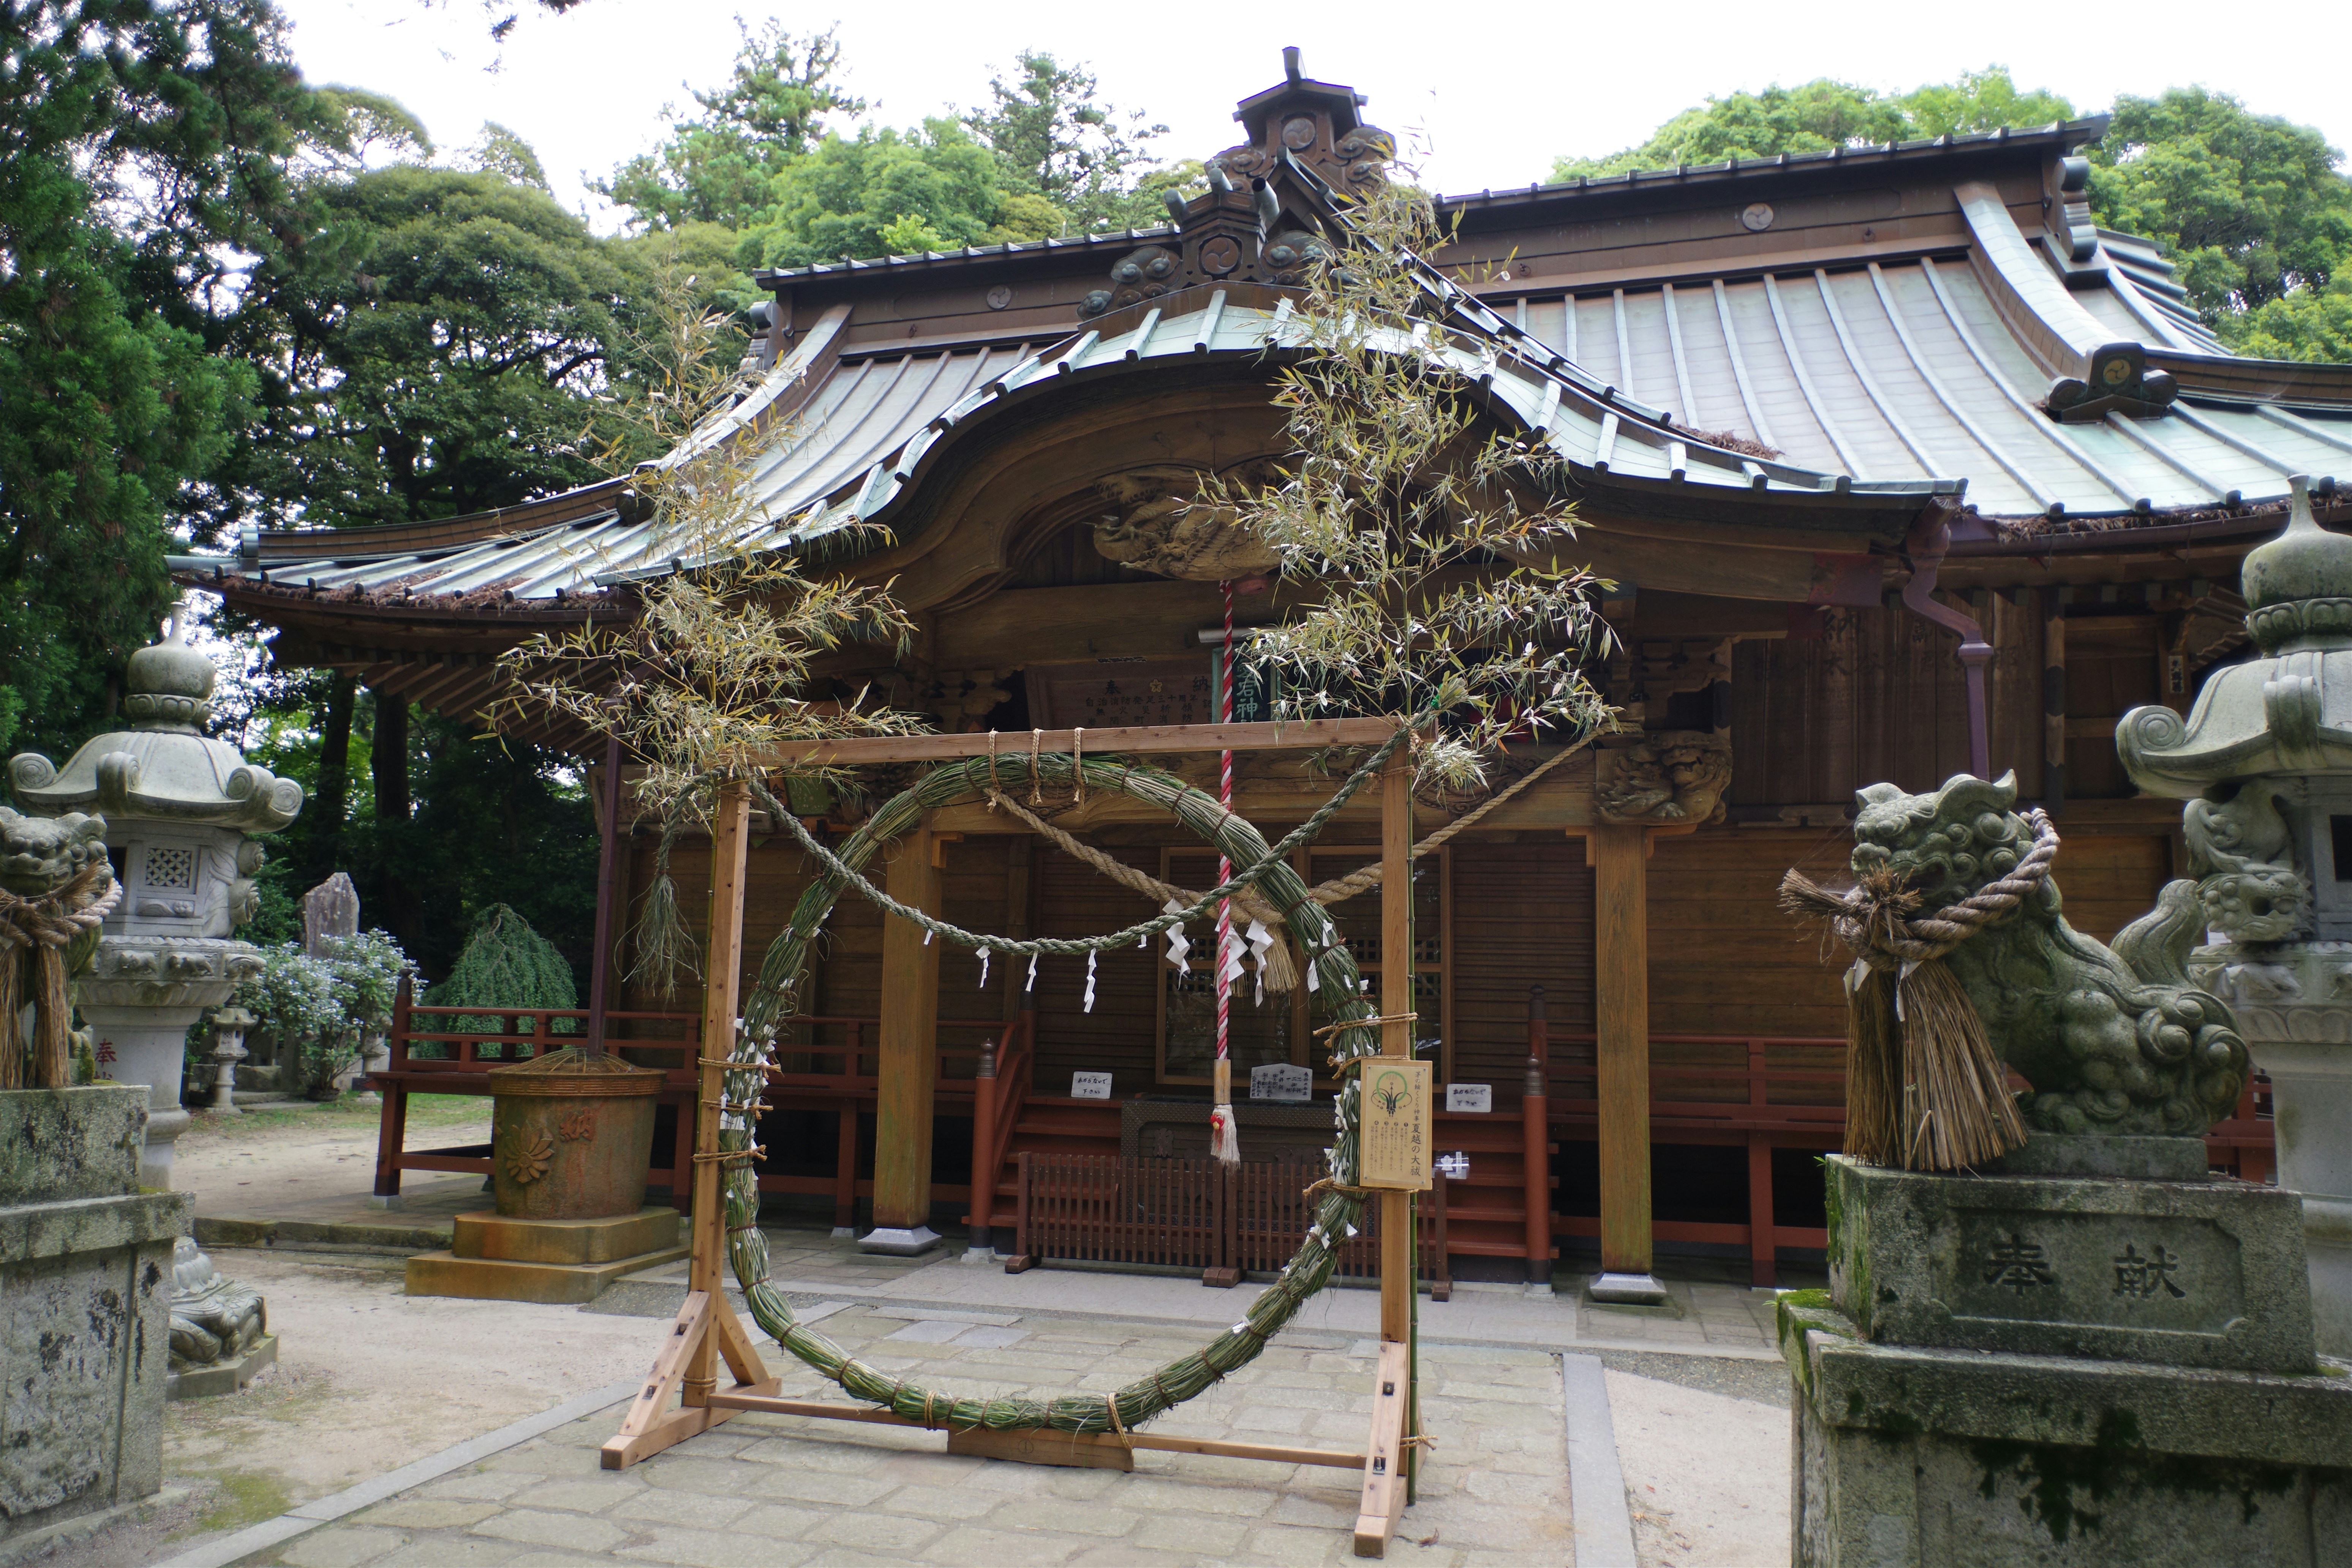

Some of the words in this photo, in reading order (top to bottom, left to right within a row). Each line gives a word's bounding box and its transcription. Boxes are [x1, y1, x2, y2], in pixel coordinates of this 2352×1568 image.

[1410, 1123, 1421, 1176] 夏越の大祓
[1982, 1232, 2187, 1299] 奉献
